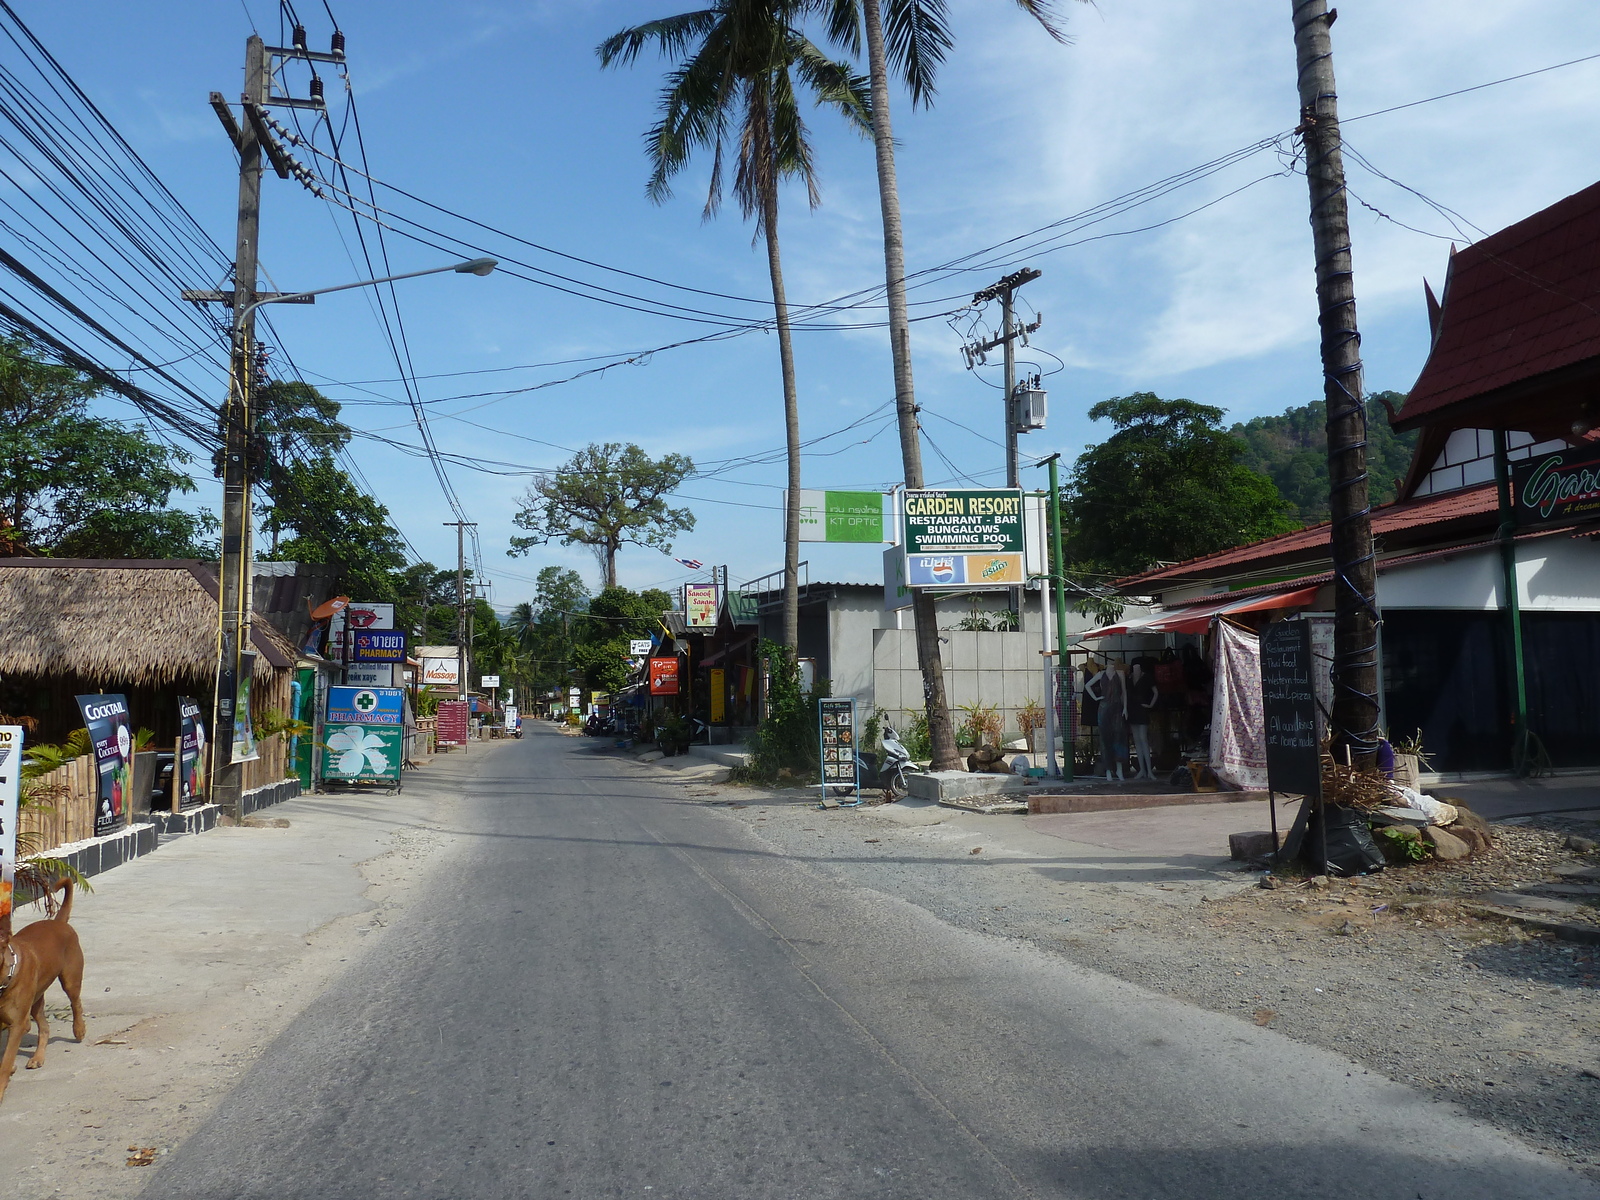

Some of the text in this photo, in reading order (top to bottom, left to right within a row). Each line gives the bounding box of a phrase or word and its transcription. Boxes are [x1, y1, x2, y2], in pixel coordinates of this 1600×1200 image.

[905, 497, 1019, 516] GARDEN RESORT
[1562, 503, 1572, 515] A
[830, 517, 879, 526] KT OPTIC
[909, 516, 983, 525] RESTAURANT
[994, 515, 1017, 524] BAR
[927, 525, 1000, 534] BUNGALOWS
[915, 534, 1013, 543] SWIMMING POOL
[371, 635, 404, 648] ขายยา
[359, 649, 403, 658] PHARMACY
[1282, 653, 1297, 668] food
[425, 670, 457, 682] Massage
[1294, 667, 1308, 685] food
[329, 712, 400, 723] PHARMACY
[1270, 715, 1280, 732] All
